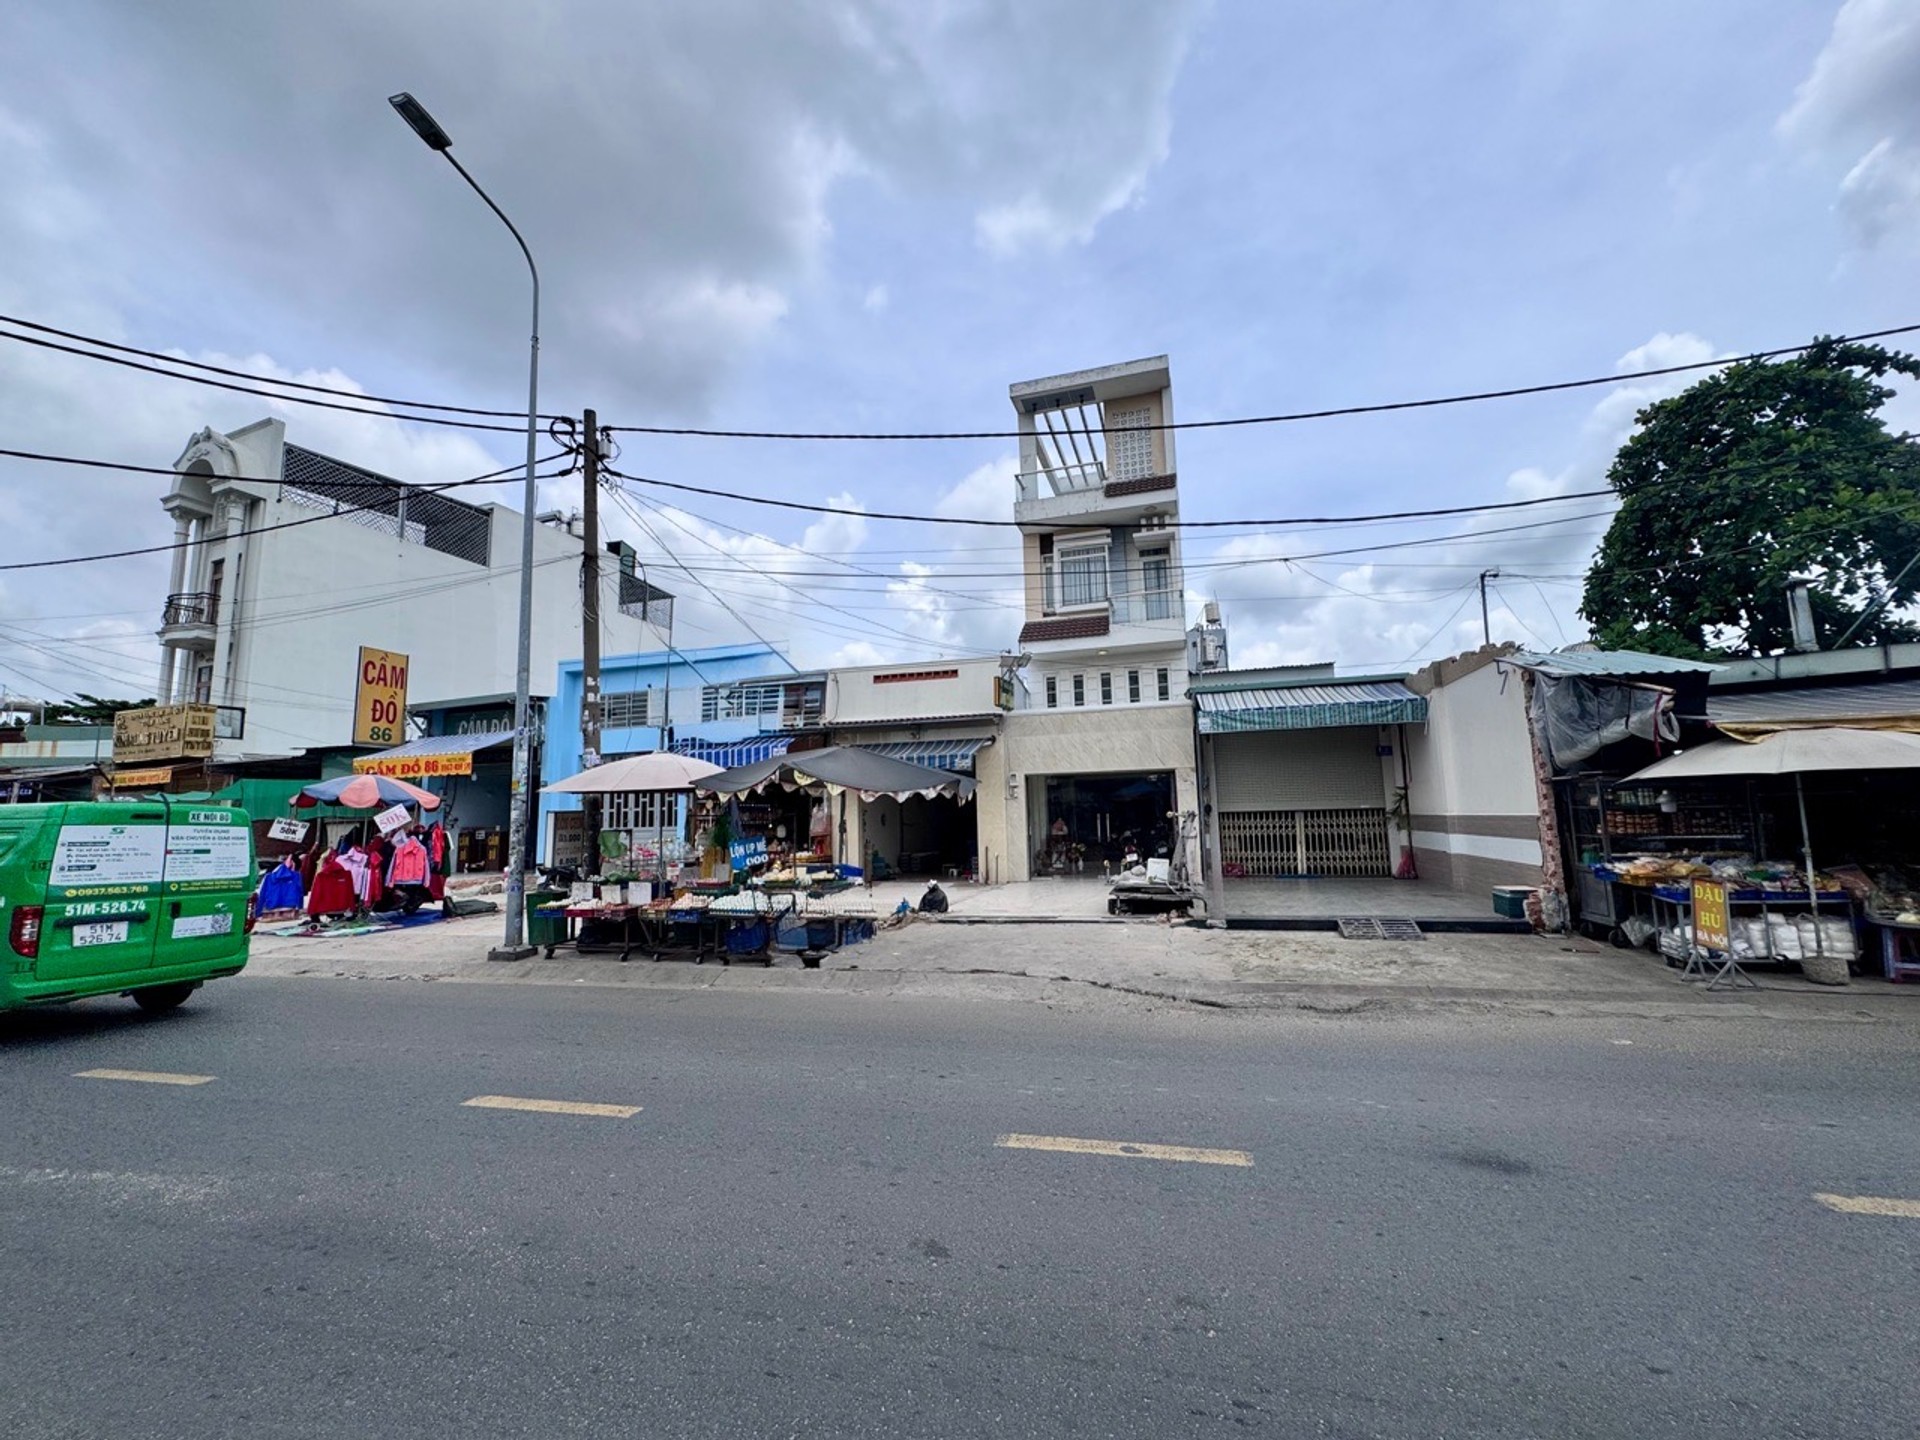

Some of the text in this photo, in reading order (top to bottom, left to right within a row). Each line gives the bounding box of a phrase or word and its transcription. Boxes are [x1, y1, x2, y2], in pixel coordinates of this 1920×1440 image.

[363, 653, 405, 690] CẦM
[371, 691, 397, 725] ĐỒ
[369, 726, 392, 742] 86
[424, 760, 439, 773] 86
[190, 813, 202, 821] XE
[65, 901, 146, 916] 51M-526.74
[89, 924, 113, 934] 51M
